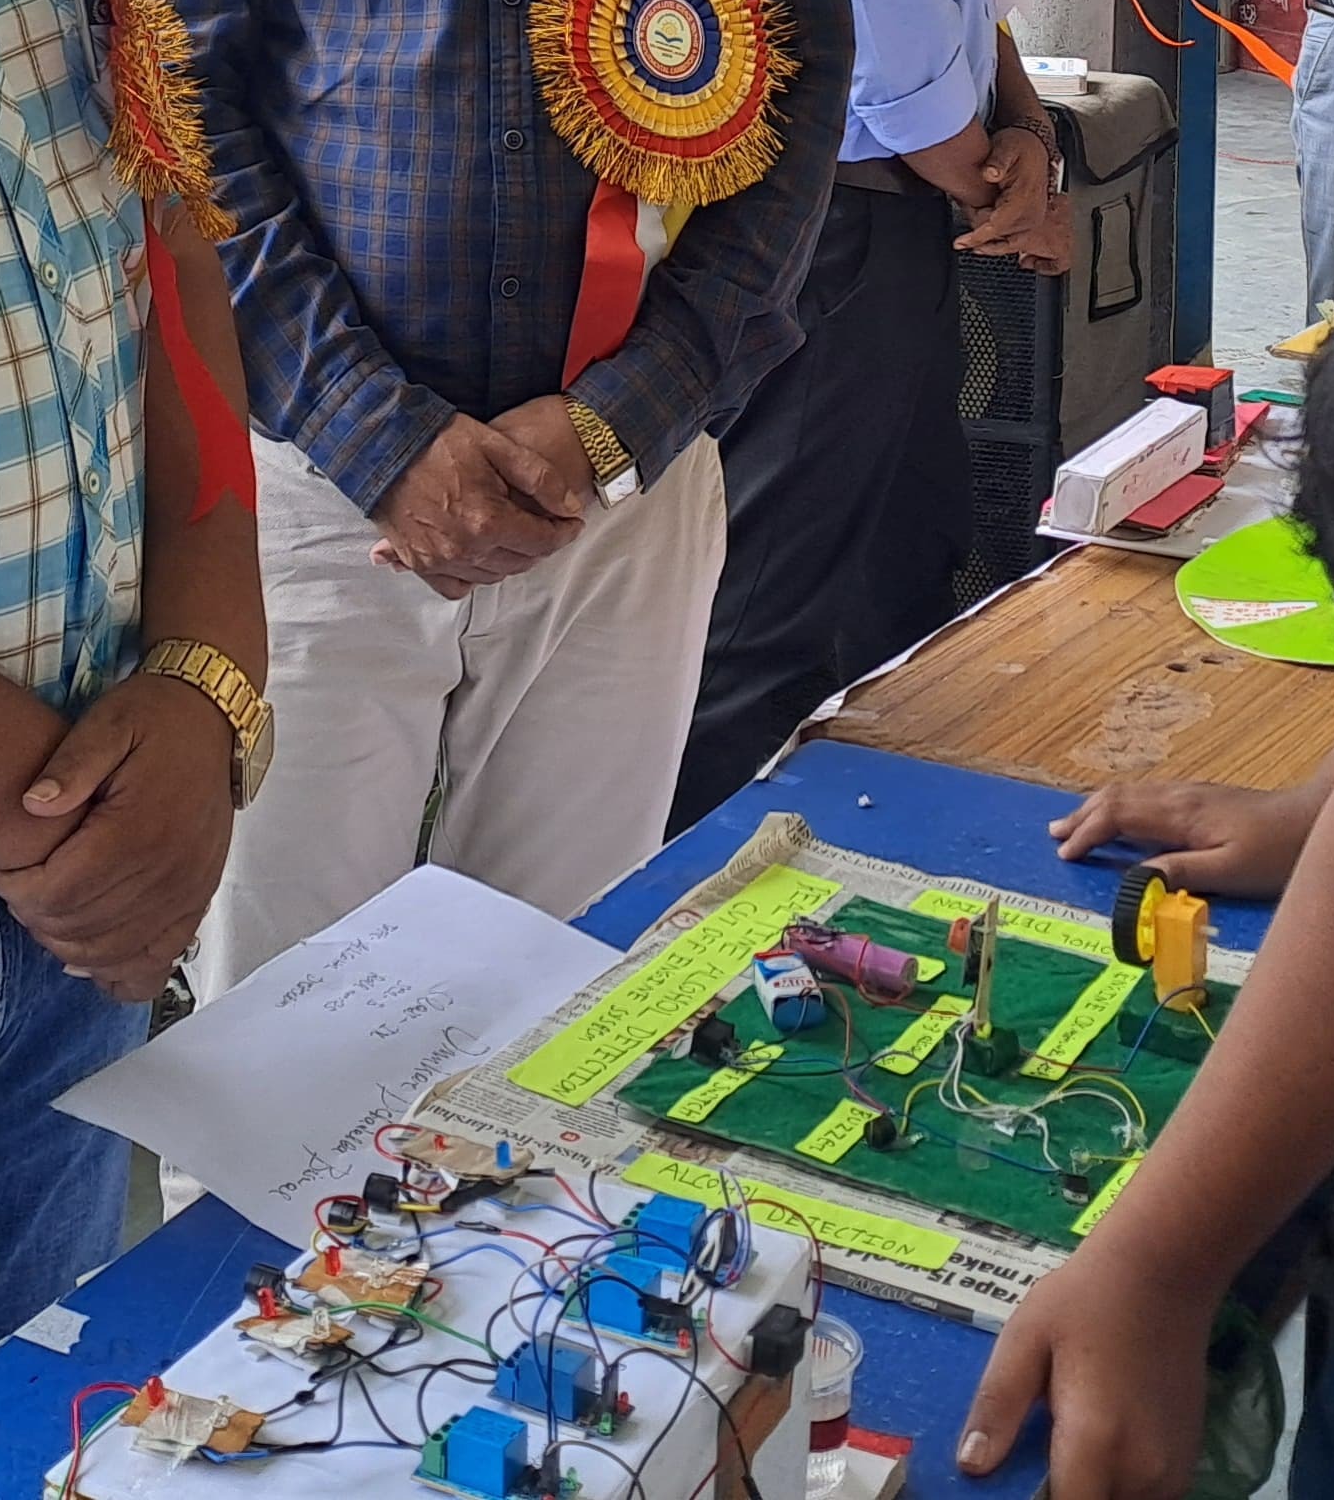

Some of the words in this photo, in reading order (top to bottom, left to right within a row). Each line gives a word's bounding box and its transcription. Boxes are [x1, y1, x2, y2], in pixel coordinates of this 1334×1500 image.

[932, 895, 1053, 935] DETETION
[1061, 931, 1113, 956] OHOL
[552, 1024, 658, 1097] DETECTION
[765, 1205, 917, 1259] DETECTION
